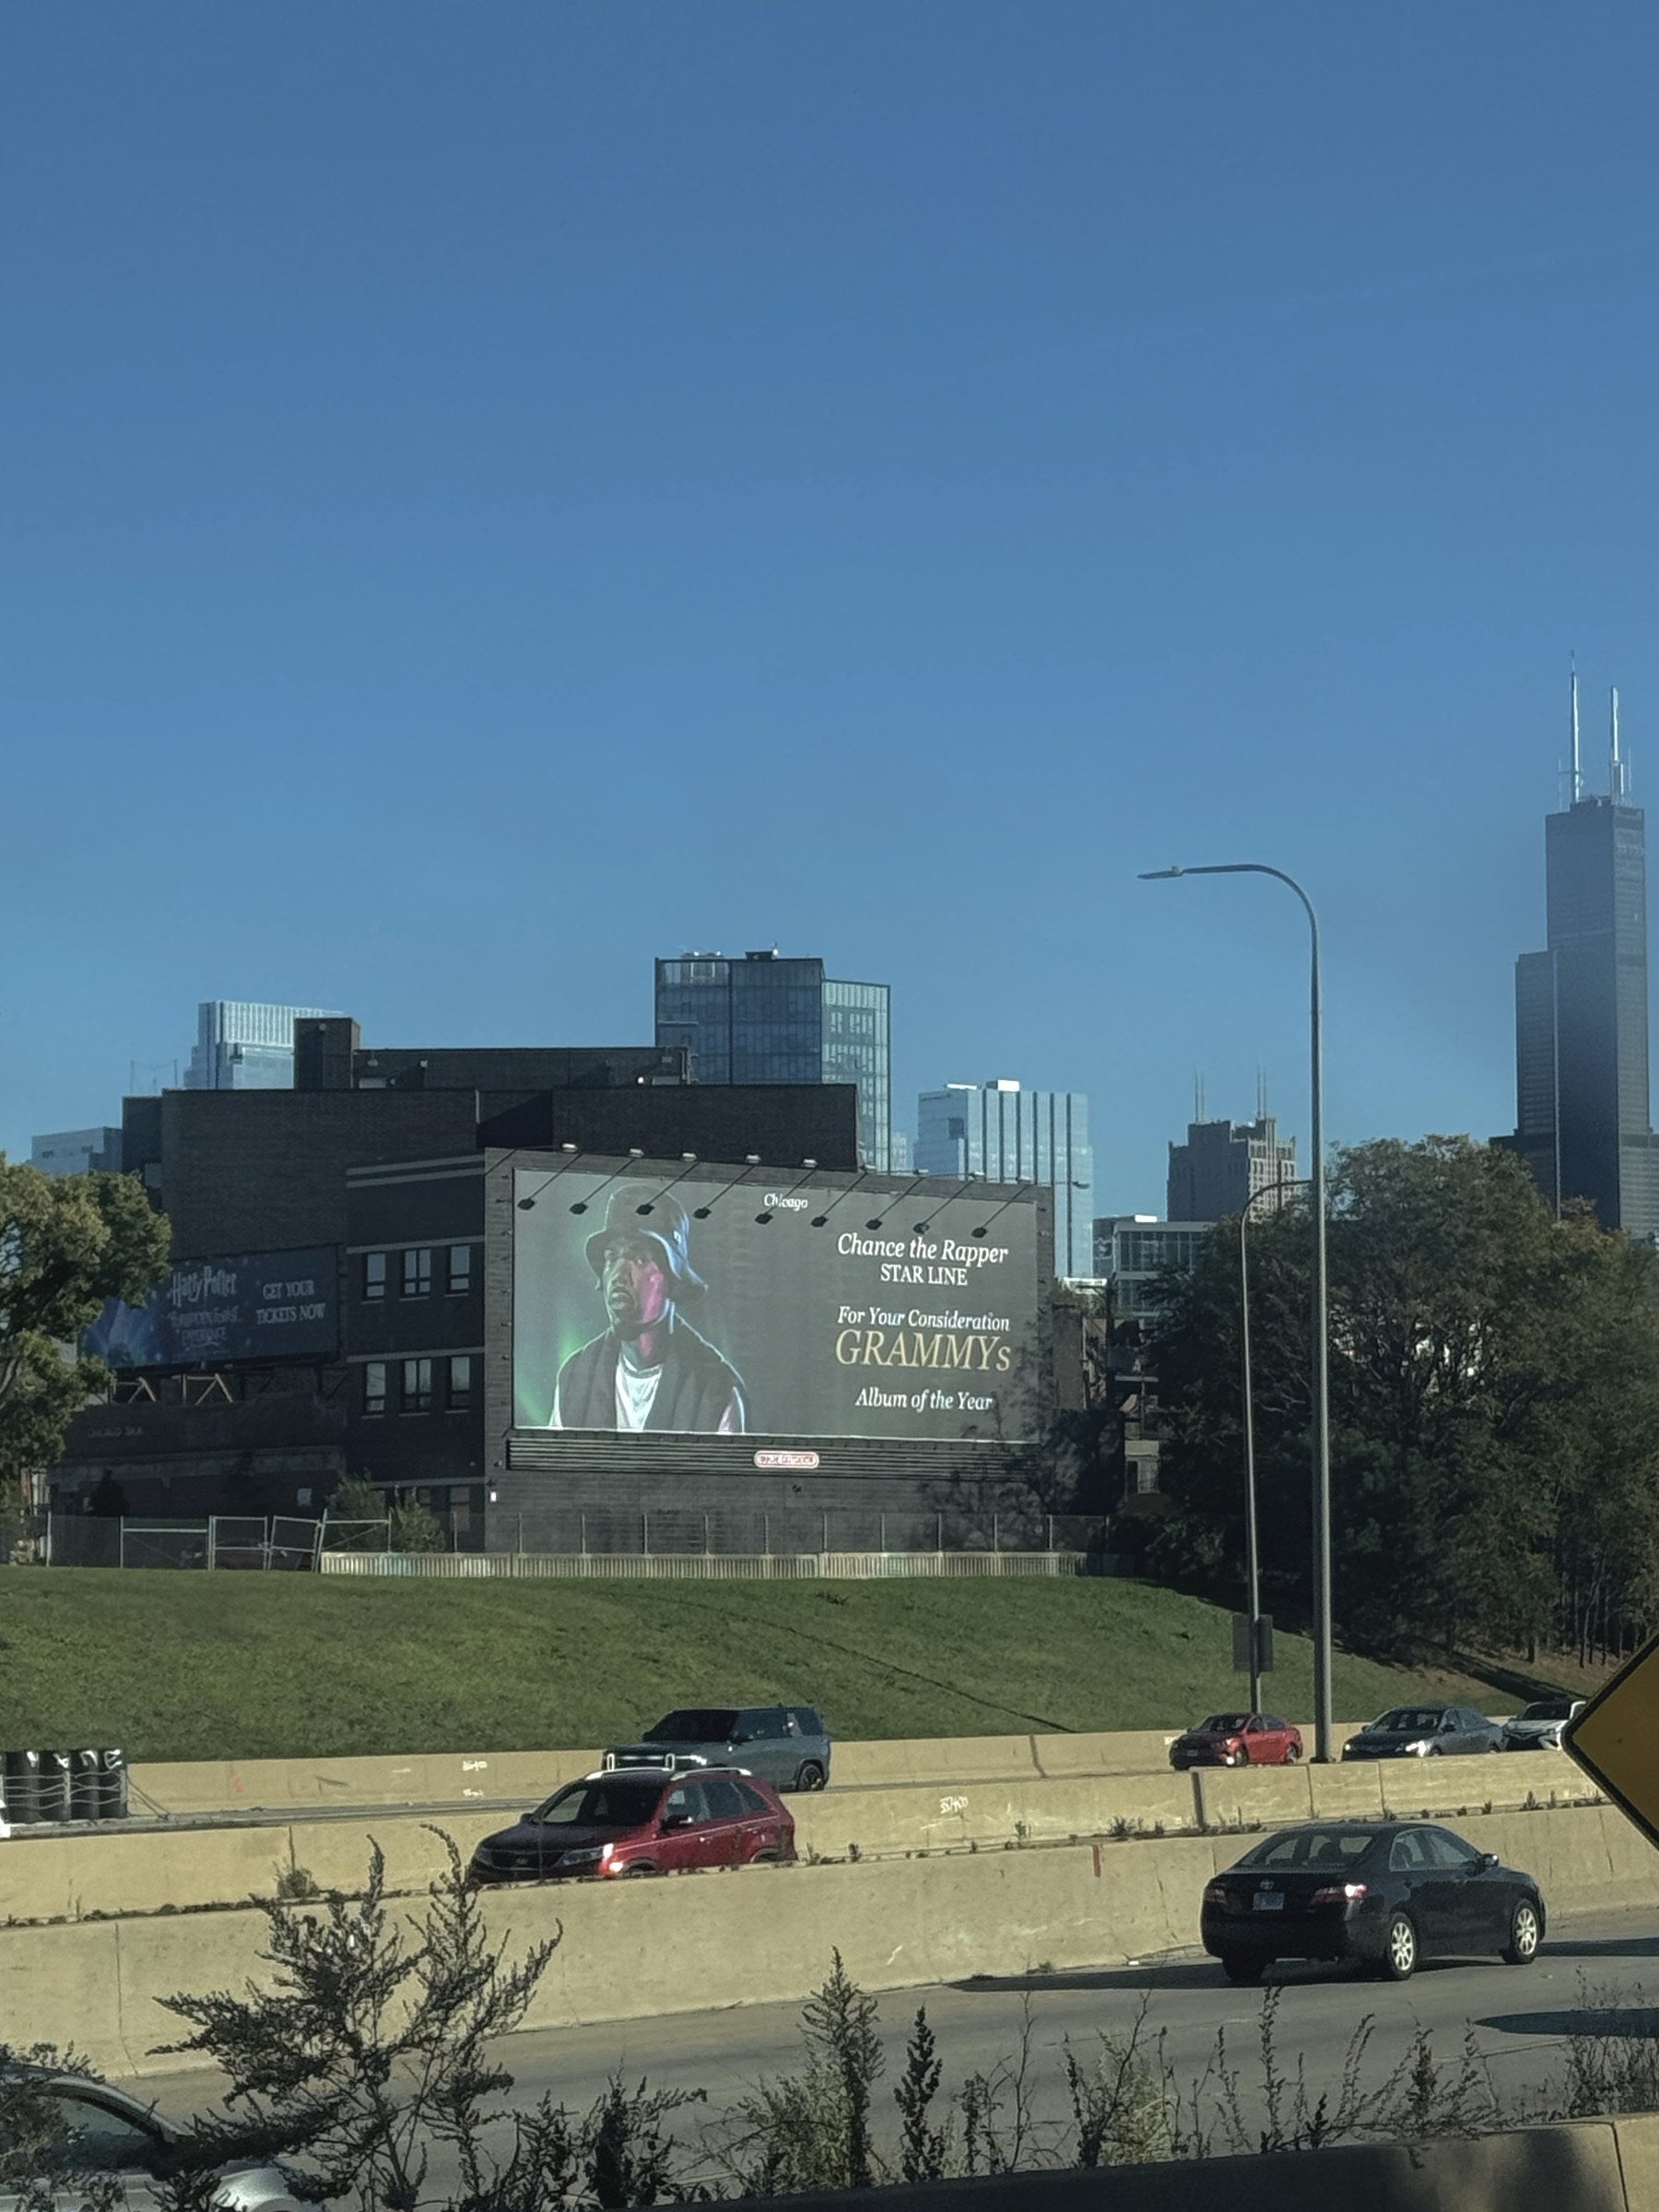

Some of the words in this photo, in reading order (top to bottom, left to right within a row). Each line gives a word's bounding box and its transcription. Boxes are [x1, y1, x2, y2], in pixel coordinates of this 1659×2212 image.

[763, 1192, 808, 1211] Chicago
[837, 1232, 905, 1258] Chance
[909, 1236, 937, 1259] the
[941, 1240, 1008, 1268] Rapper
[171, 1269, 203, 1308] Harry
[203, 1265, 238, 1298] Potter
[879, 1263, 924, 1283] STAR
[927, 1267, 969, 1286] LINE
[262, 1282, 284, 1300] GET
[285, 1278, 315, 1298] YOUR
[255, 1305, 298, 1325] TICKETS
[299, 1302, 326, 1321] NOW
[837, 1306, 865, 1324] For
[869, 1307, 906, 1326] Your
[908, 1309, 1010, 1332] Consideration
[854, 1387, 907, 1408] Album
[911, 1389, 929, 1413] of
[930, 1390, 954, 1409] the
[958, 1392, 994, 1411] Year
